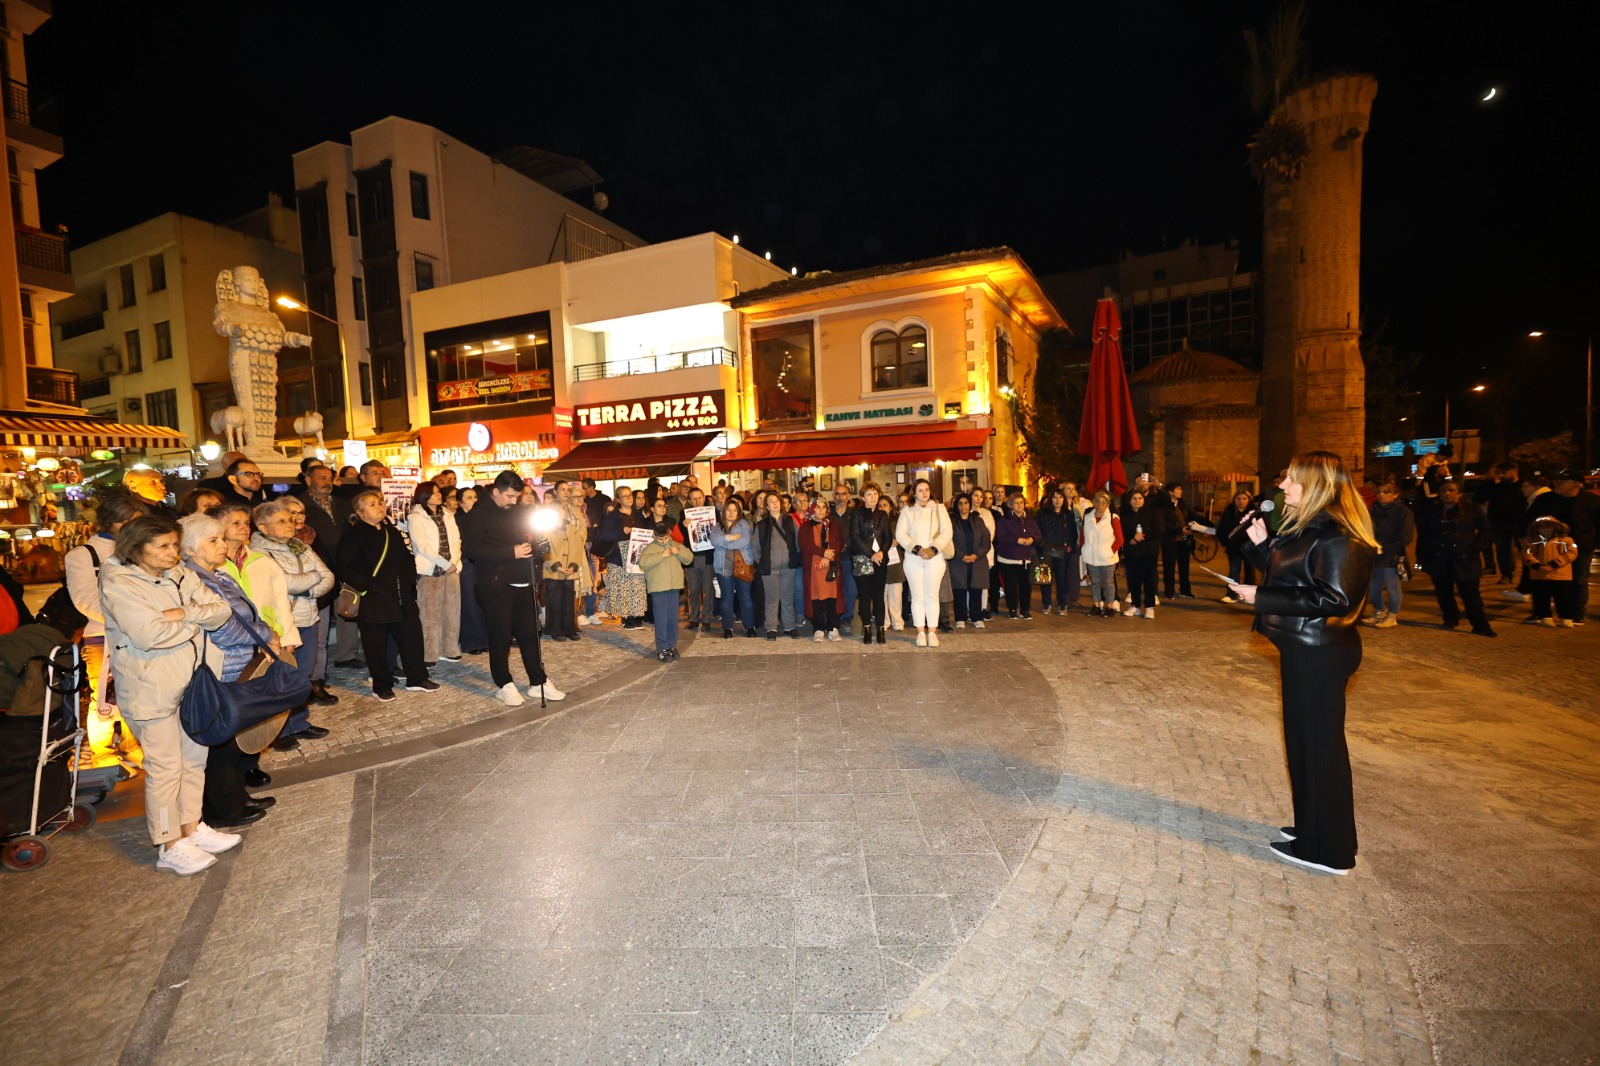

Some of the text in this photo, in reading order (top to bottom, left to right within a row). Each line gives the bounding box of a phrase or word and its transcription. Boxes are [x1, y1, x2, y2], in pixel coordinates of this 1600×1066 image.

[577, 403, 646, 426] TERRA
[667, 415, 718, 428] 44 44 500
[826, 406, 913, 422] KAHVE HATIRASI
